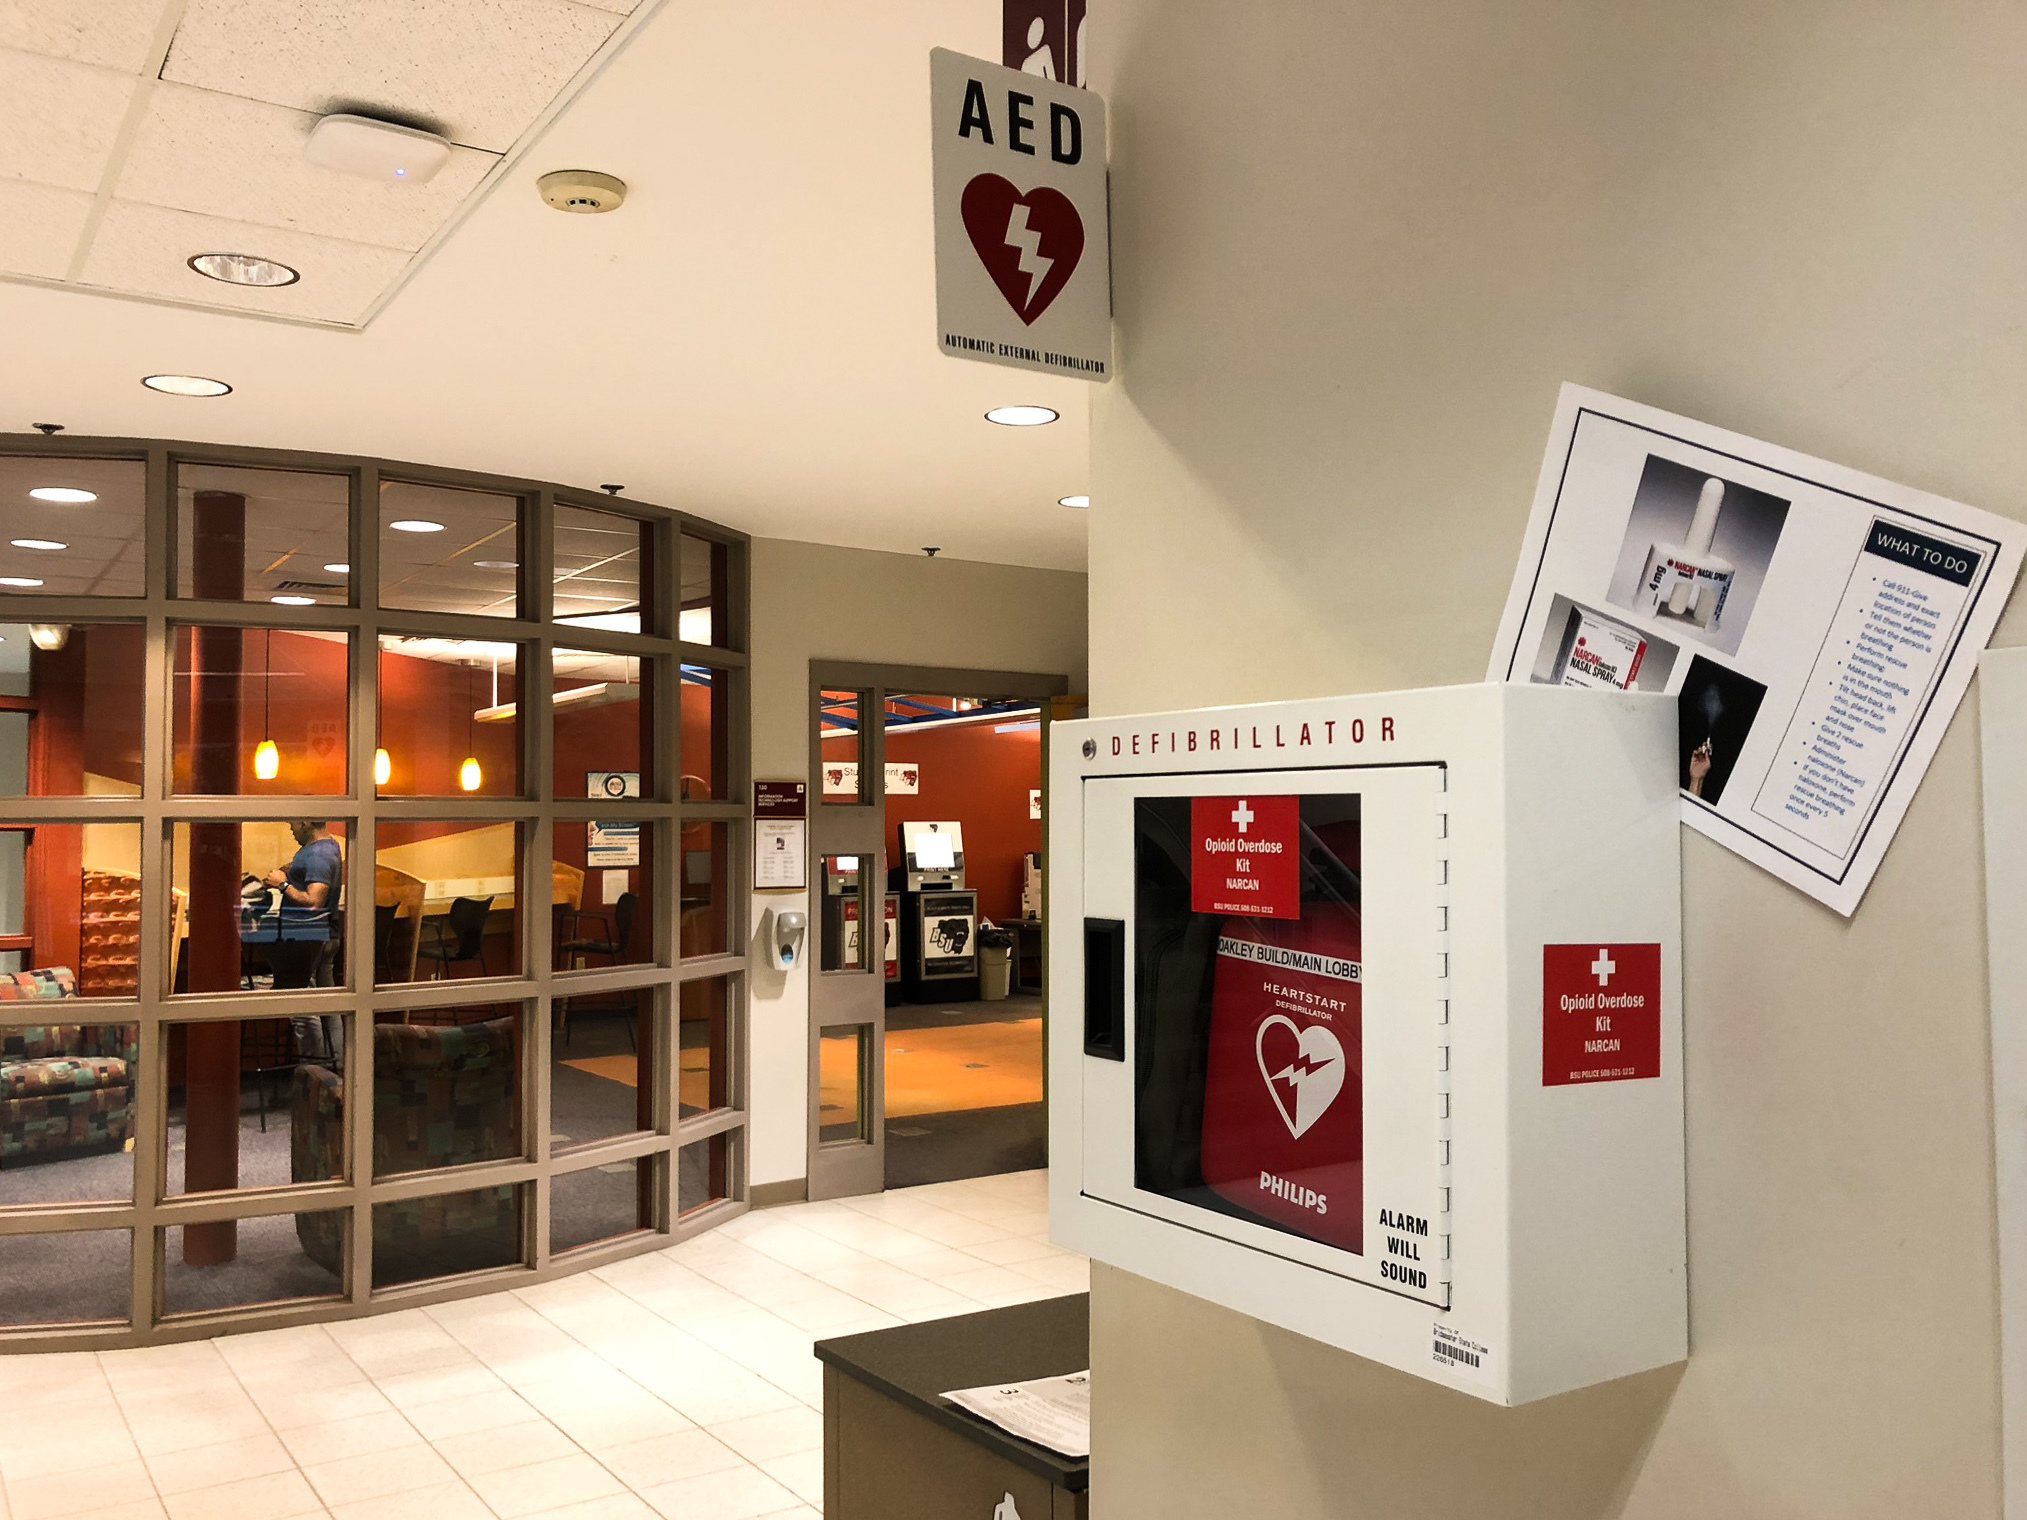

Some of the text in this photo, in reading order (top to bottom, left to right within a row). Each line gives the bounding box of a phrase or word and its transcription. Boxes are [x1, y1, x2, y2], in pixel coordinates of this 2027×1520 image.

[958, 77, 1082, 166] AED
[945, 333, 1105, 374] AUTOMATIC EXTERNAL DEFIBRILLATOR
[1877, 532, 1967, 573] WHAT TO DO
[1653, 565, 1667, 584] mg
[1882, 579, 1896, 589] Call
[1649, 582, 1658, 592] 4
[1873, 600, 1901, 616] location
[1909, 615, 1936, 629] person
[1877, 591, 1940, 619] address and exact
[1870, 610, 1932, 640] Tell them whether
[1860, 631, 1893, 652] breathing
[1873, 626, 1886, 635] not
[1886, 630, 1899, 640] the
[1898, 636, 1924, 649] person
[1574, 647, 1600, 666] NARCAN
[1851, 652, 1885, 672] breathing
[1855, 642, 1907, 669] Perform rescue
[1570, 657, 1592, 675] NASAL
[1592, 666, 1614, 684] SPRAY
[1846, 662, 1910, 696] Make sure nothing
[1839, 683, 1849, 693] Tilt
[1849, 688, 1868, 701] head
[1857, 679, 1869, 689] the
[1869, 685, 1892, 699] mouth
[1829, 705, 1886, 733] mask over mouth
[1849, 702, 1869, 714] place
[1869, 709, 1884, 720] face
[1825, 715, 1854, 732] and nose
[1111, 717, 1396, 756] DEFIBRILLATOR
[1816, 734, 1840, 750] breaths
[1820, 724, 1863, 748] Give 2 rescue
[1811, 744, 1846, 764] Administer
[1807, 754, 1865, 787] naloxone (Narcan)
[1808, 768, 1820, 777] you
[1821, 773, 1839, 786] don't
[1838, 781, 1854, 794] have
[1789, 794, 1805, 805] once
[1805, 801, 1823, 815] every
[1793, 784, 1845, 815] rescue breathing
[1828, 790, 1855, 806] perform
[1784, 803, 1809, 819] seconds
[1205, 838, 1283, 854] Opioid Overdose
[1236, 858, 1250, 873] Kit
[1226, 878, 1260, 891] NARCAN
[1224, 903, 1240, 911] POLICE
[929, 927, 954, 954] BSU
[1218, 938, 1255, 959] OAKLEY
[1257, 946, 1322, 972] BUILD/MAIN
[1263, 981, 1347, 1013] HEARTSTART
[1560, 992, 1645, 1013] Opioid Overdose
[1275, 999, 1333, 1021] DEFIBRILLATOR
[1595, 1016, 1612, 1032] Kit
[1584, 1039, 1621, 1053] NARCAN
[1581, 1069, 1600, 1078] POLICE
[1259, 1170, 1328, 1215] PHILIPS
[1379, 1208, 1428, 1237] ALARM
[1387, 1235, 1421, 1262] WILL
[1380, 1260, 1428, 1290] SOUND
